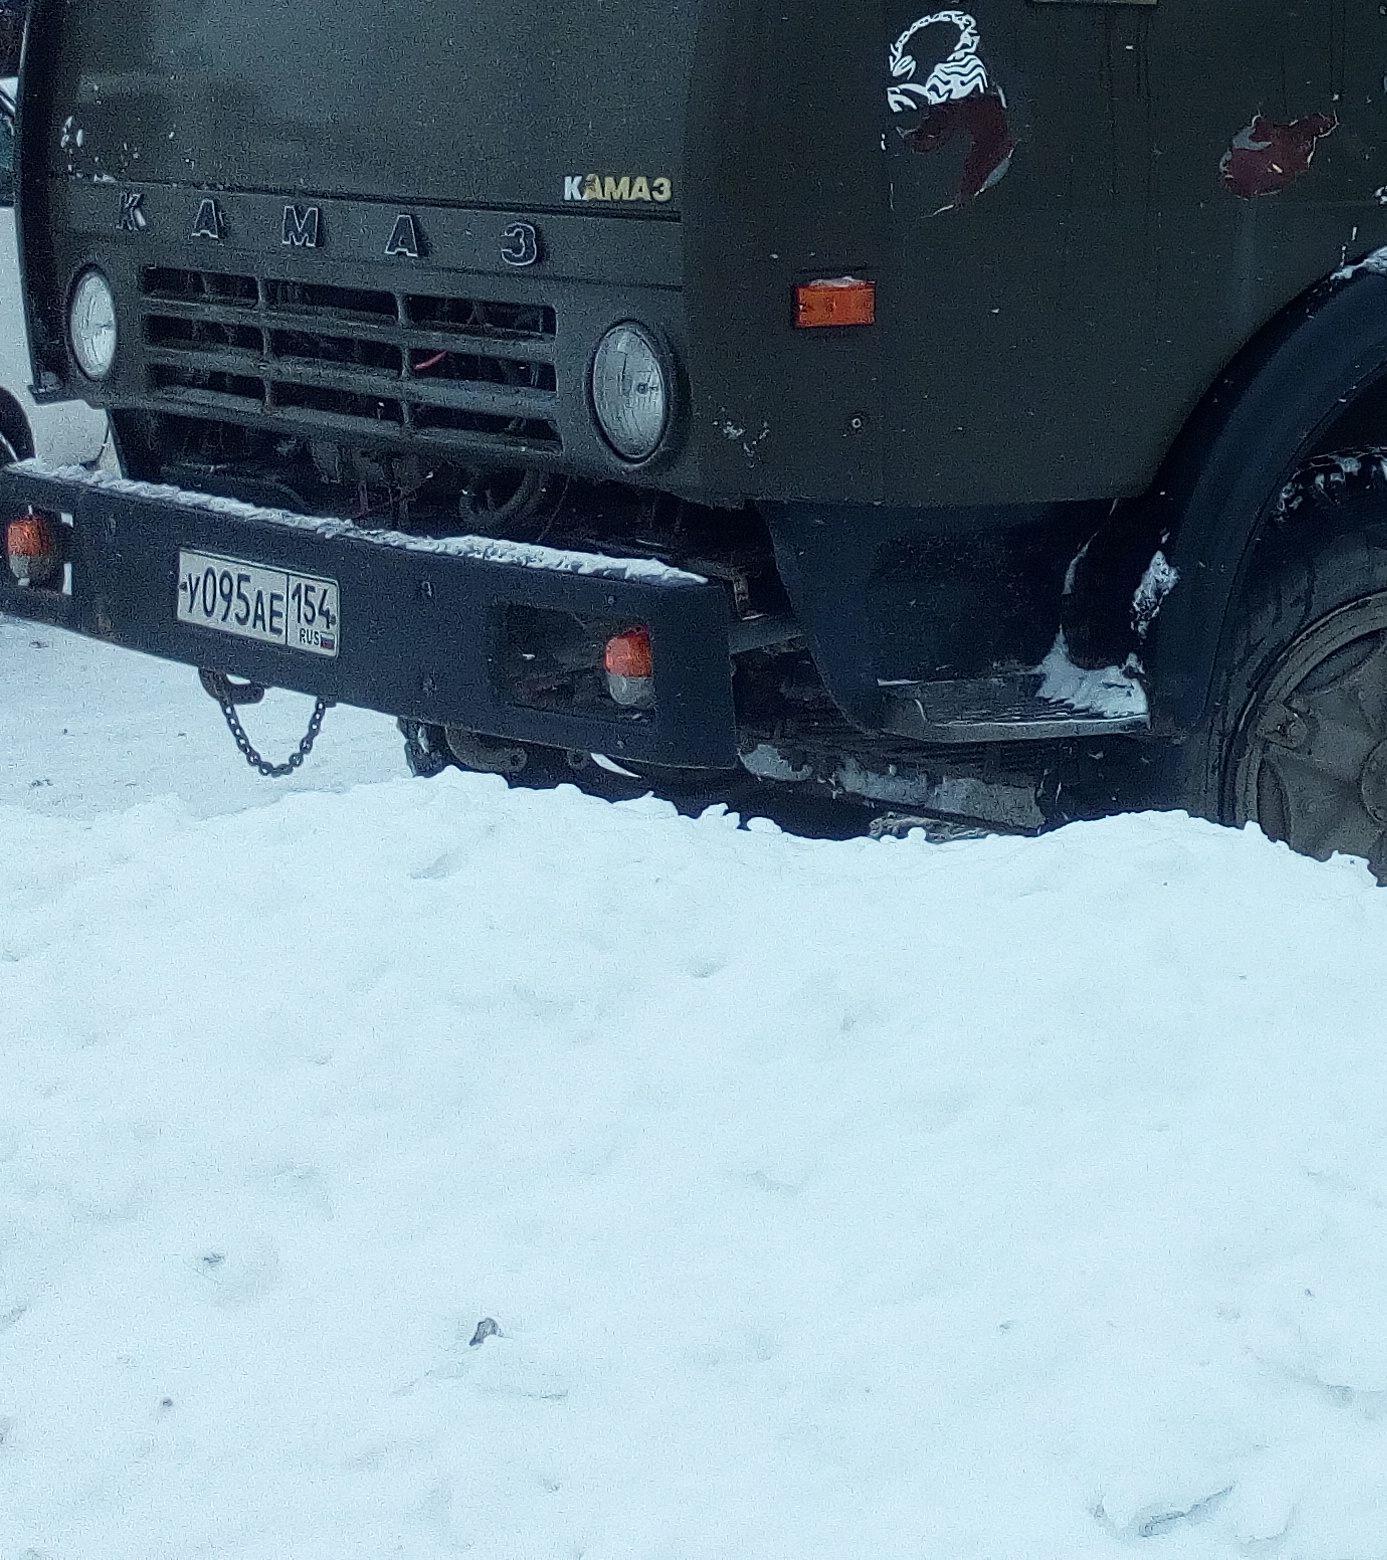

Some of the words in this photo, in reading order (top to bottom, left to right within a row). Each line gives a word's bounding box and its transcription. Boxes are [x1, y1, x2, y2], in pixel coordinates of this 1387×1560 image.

[563, 173, 672, 202] КАМАЗ
[115, 190, 539, 267] КАМАЗ
[291, 582, 332, 631] 154
[299, 627, 321, 646] RUS
